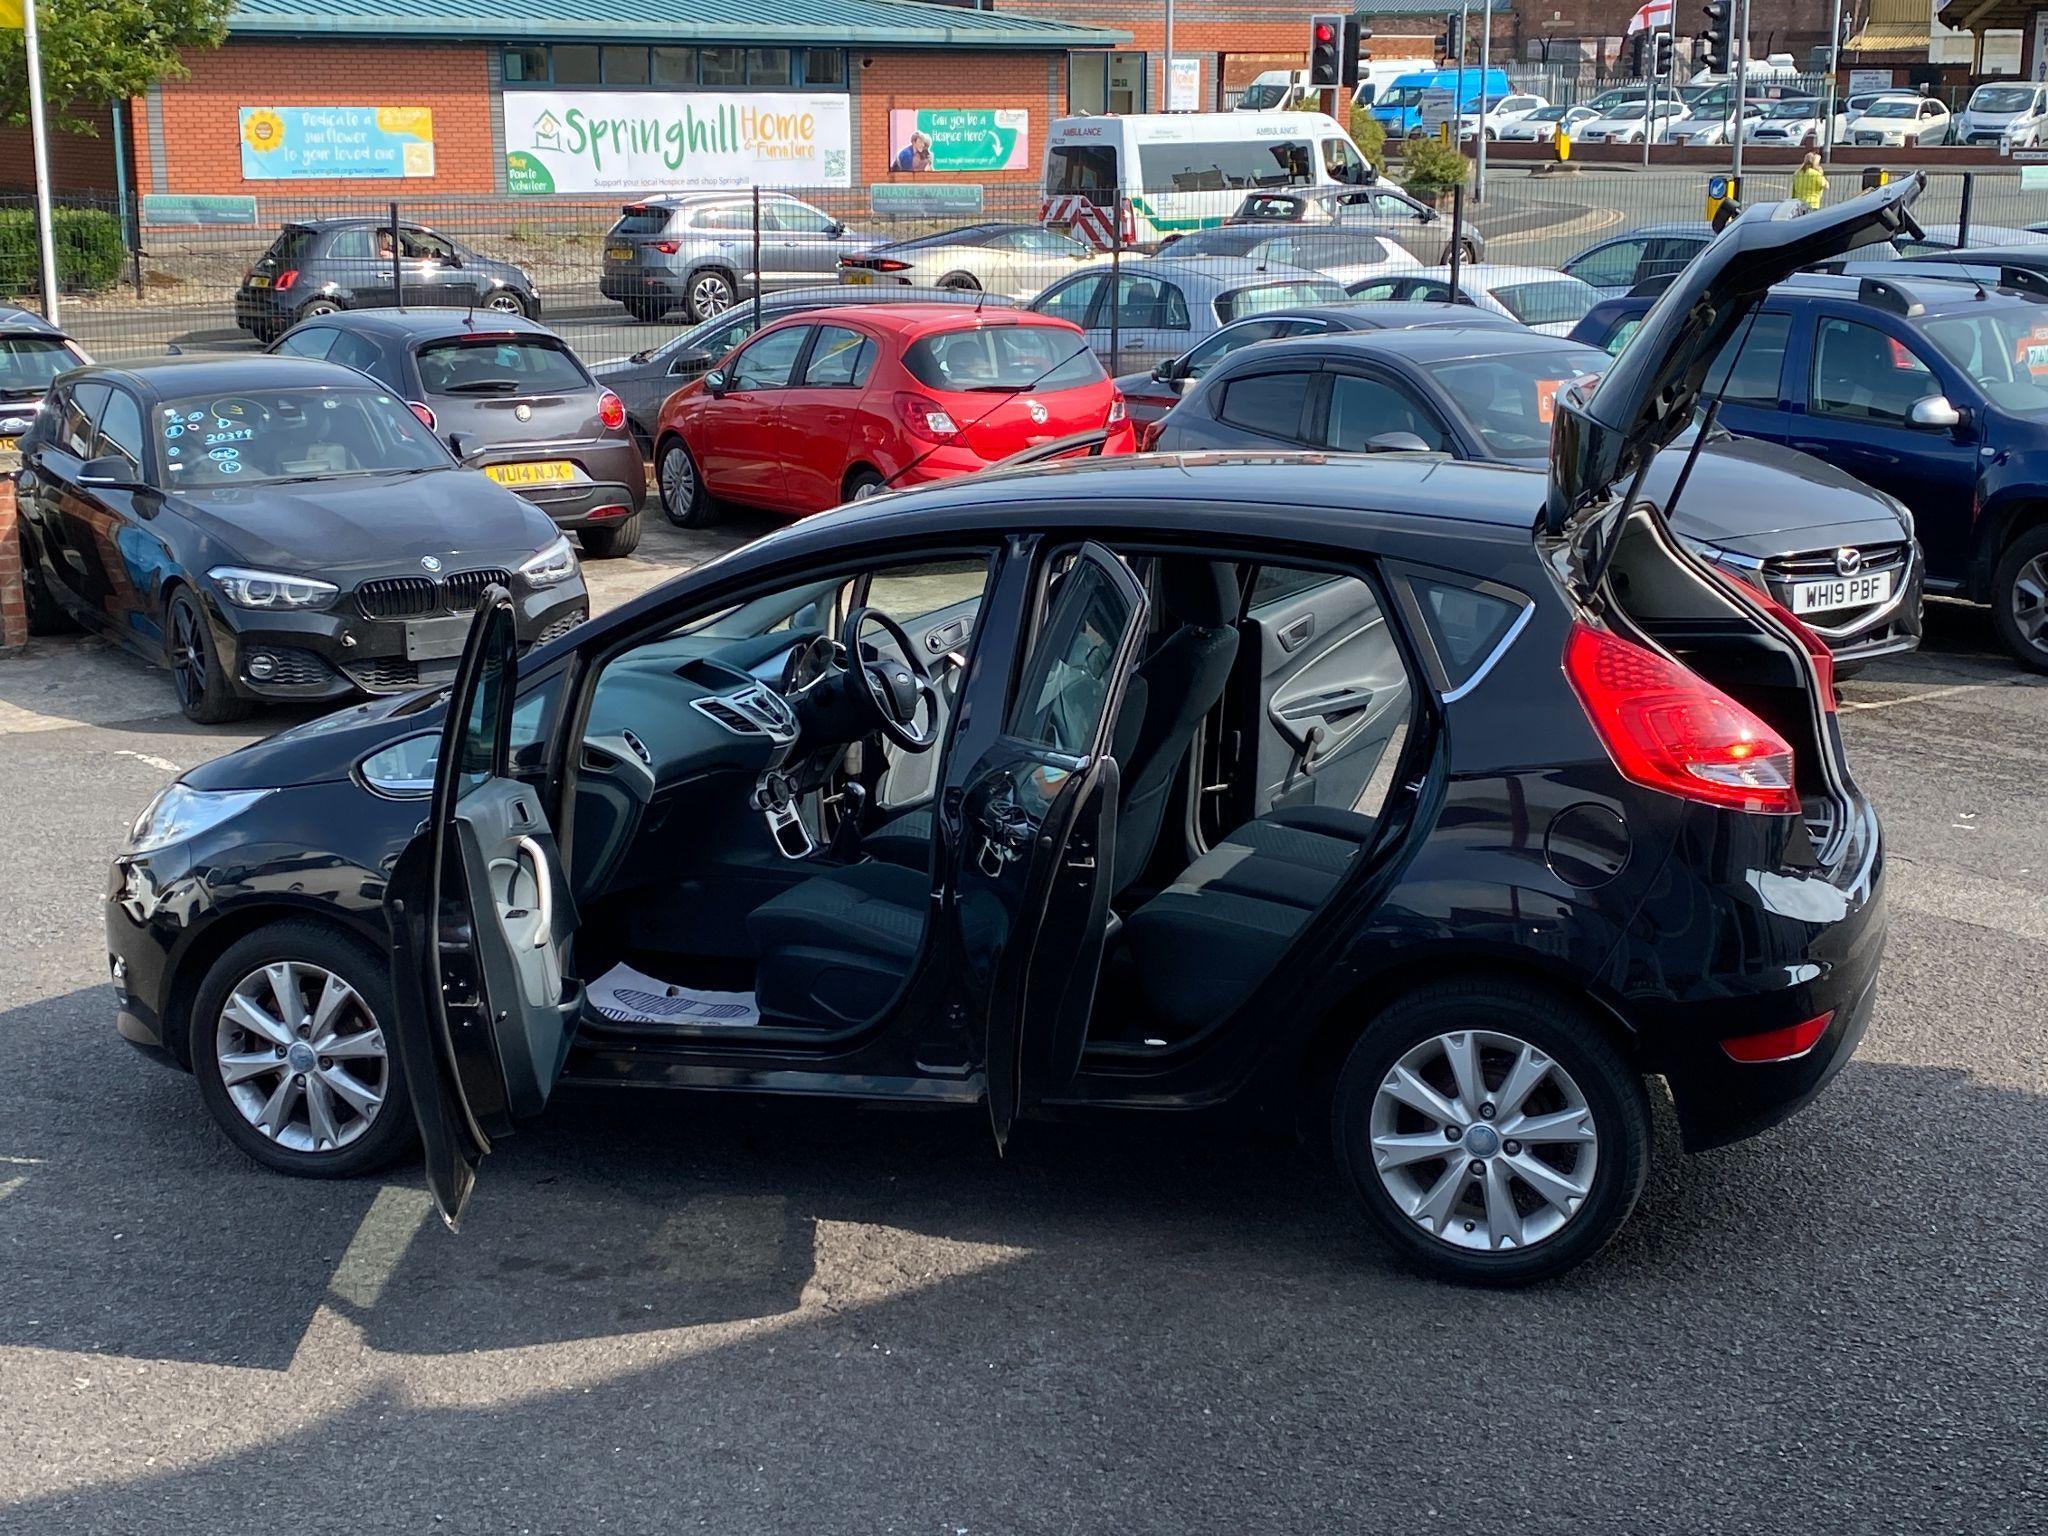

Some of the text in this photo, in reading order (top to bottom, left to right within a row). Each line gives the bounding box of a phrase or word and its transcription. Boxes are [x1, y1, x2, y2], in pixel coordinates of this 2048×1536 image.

[302, 112, 359, 127] Dedicate
[363, 115, 372, 126] a
[932, 112, 987, 130] Can you be a
[304, 127, 368, 144] sunflower
[565, 103, 815, 172] Springhill Home
[931, 129, 961, 146] Hospice
[1062, 127, 1103, 137] AMBULANCE
[1256, 126, 1299, 136] AMBULANCE
[283, 146, 396, 167] to your loved one
[756, 140, 816, 160] Furniture
[509, 168, 538, 180] Donate
[594, 175, 750, 188] Support your local Hospice and shop Springhill
[510, 180, 548, 192] Volunteer
[873, 186, 980, 198] FINANCE AVAILABLE
[496, 464, 565, 482] WU14 NJX
[1806, 577, 1881, 608] WH19 PBF
